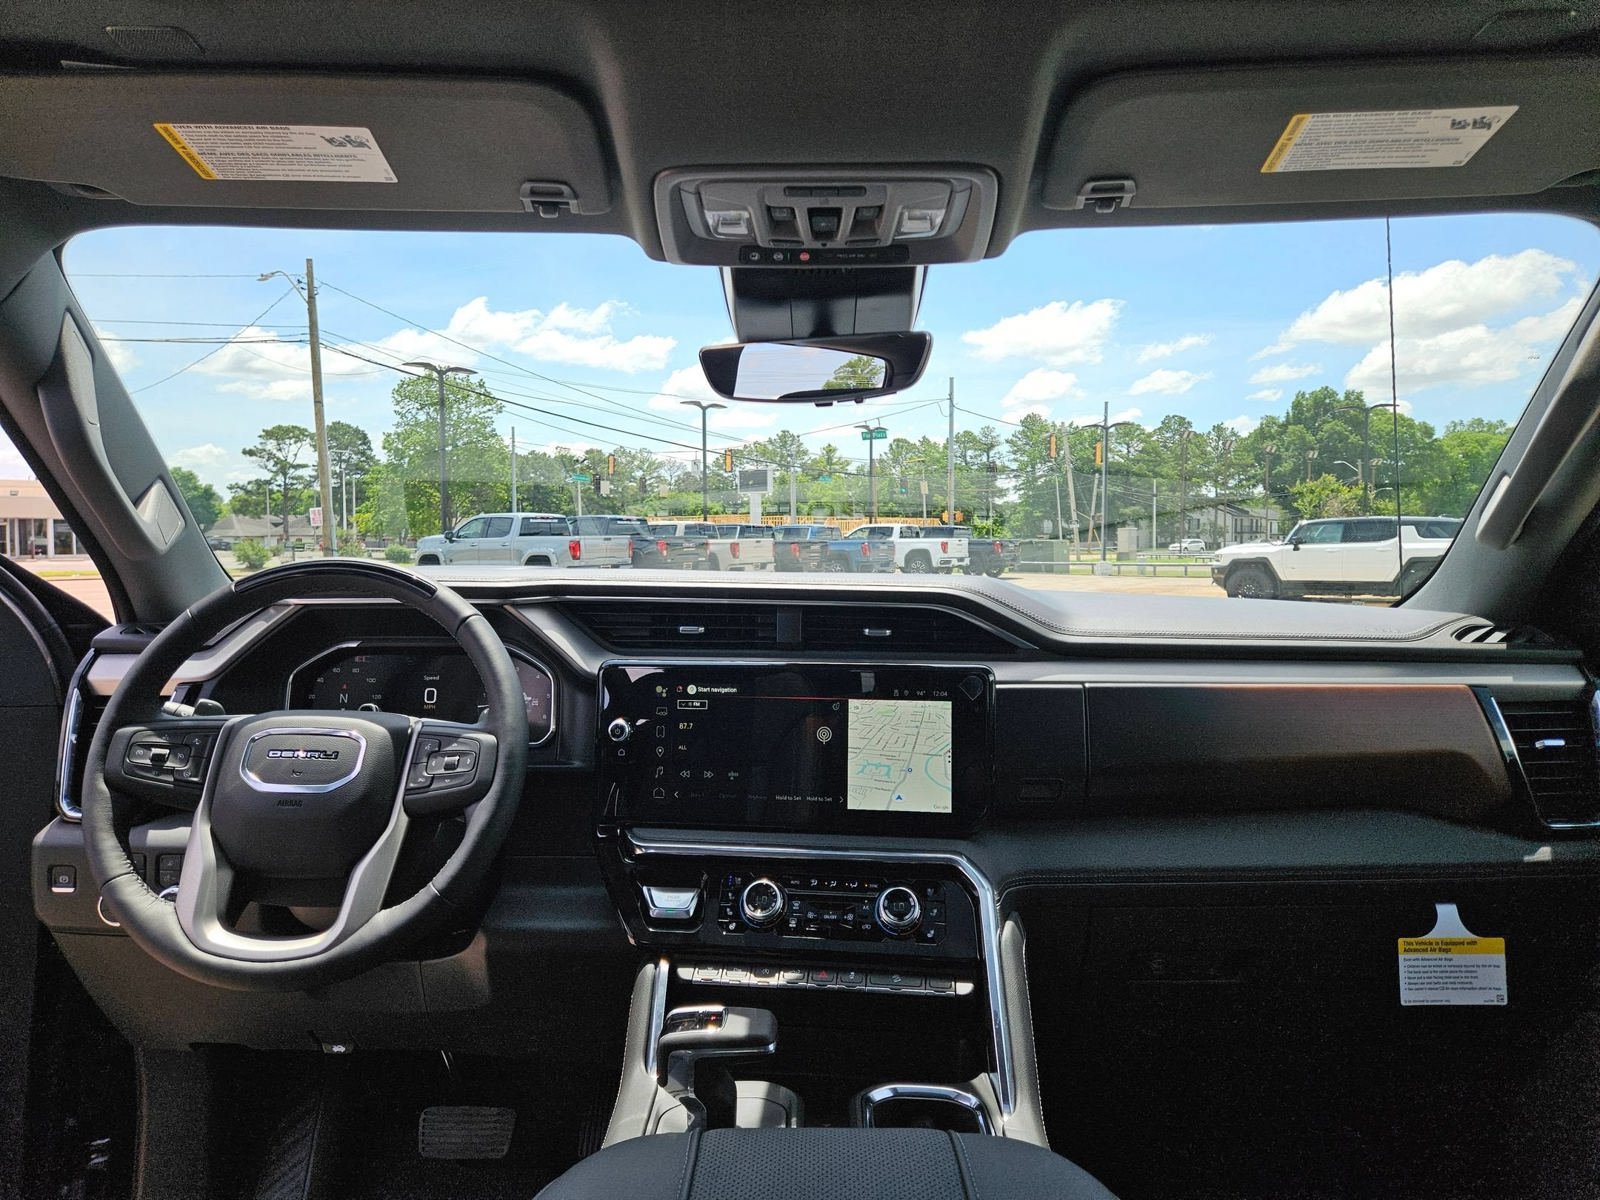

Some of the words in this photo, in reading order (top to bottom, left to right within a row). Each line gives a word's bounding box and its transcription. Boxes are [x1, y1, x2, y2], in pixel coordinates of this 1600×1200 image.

[340, 693, 348, 704] N
[424, 687, 437, 704] 0
[267, 748, 339, 760] DENALI
